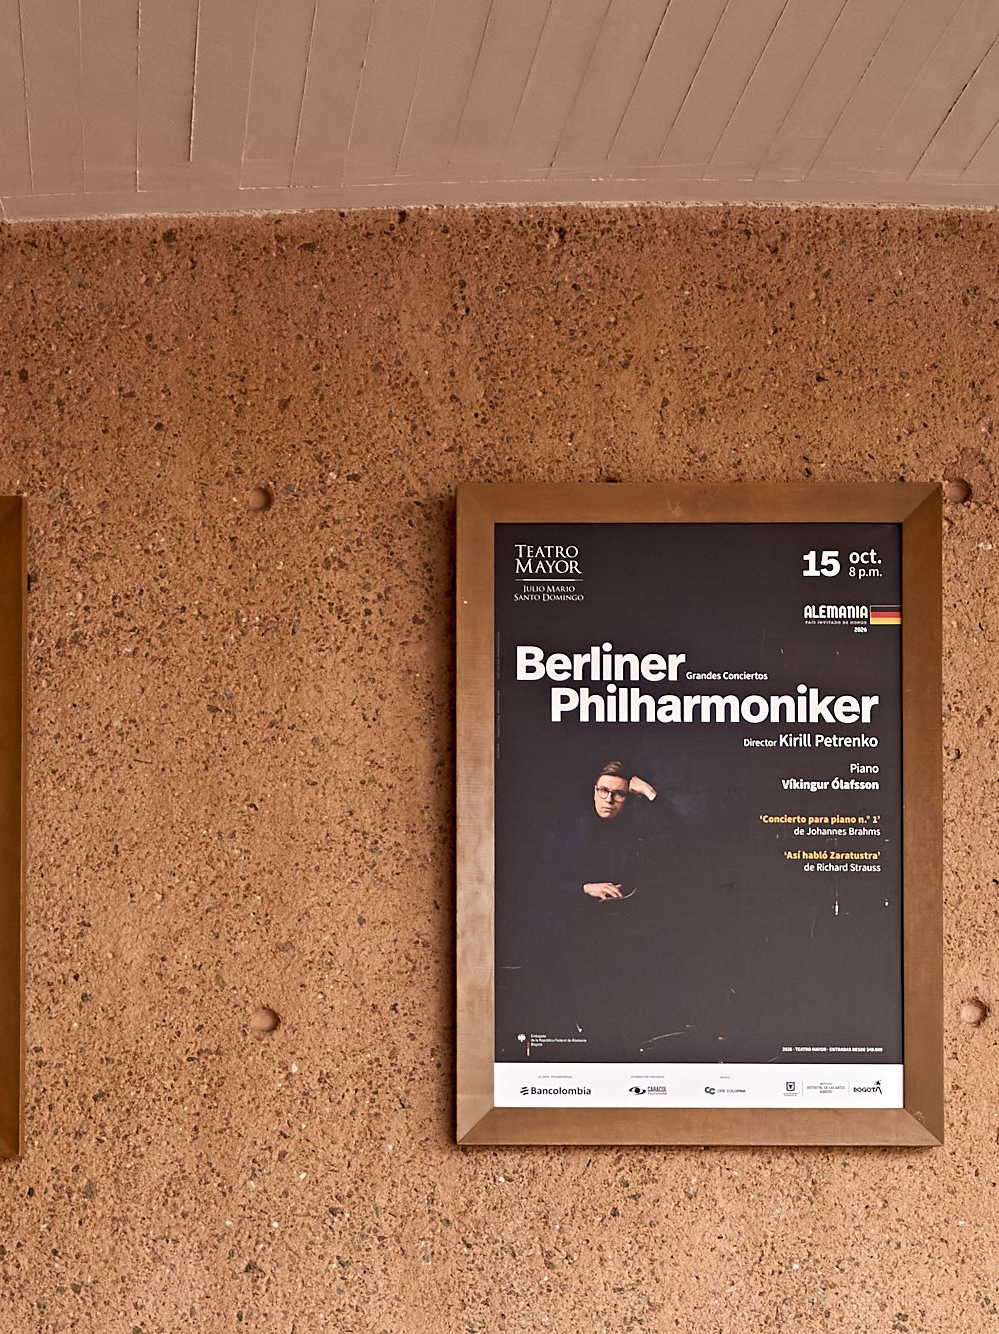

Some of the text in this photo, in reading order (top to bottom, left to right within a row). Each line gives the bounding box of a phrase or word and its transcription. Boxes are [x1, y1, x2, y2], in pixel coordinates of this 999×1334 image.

[515, 545, 579, 559] TEATRO
[849, 549, 882, 564] oct.
[515, 559, 582, 574] MAYOR
[803, 550, 841, 577] 15
[849, 567, 882, 580] 8 p.m.
[804, 605, 868, 619] ALEMANIA
[516, 642, 686, 681] Berliner
[686, 671, 768, 681] Grandes Conciertos
[551, 683, 879, 723] Philharmoniker
[743, 733, 878, 748] Director Kirill Petrenko
[850, 763, 879, 774] Piano
[781, 777, 879, 792] Víkingur Ólafsson
[808, 816, 829, 825] para
[831, 815, 857, 825] piano
[793, 827, 881, 836] de Johannes Brahms
[802, 851, 828, 860] habló
[803, 862, 882, 872] de Richard Strauss
[530, 1087, 592, 1096] Bancolombia
